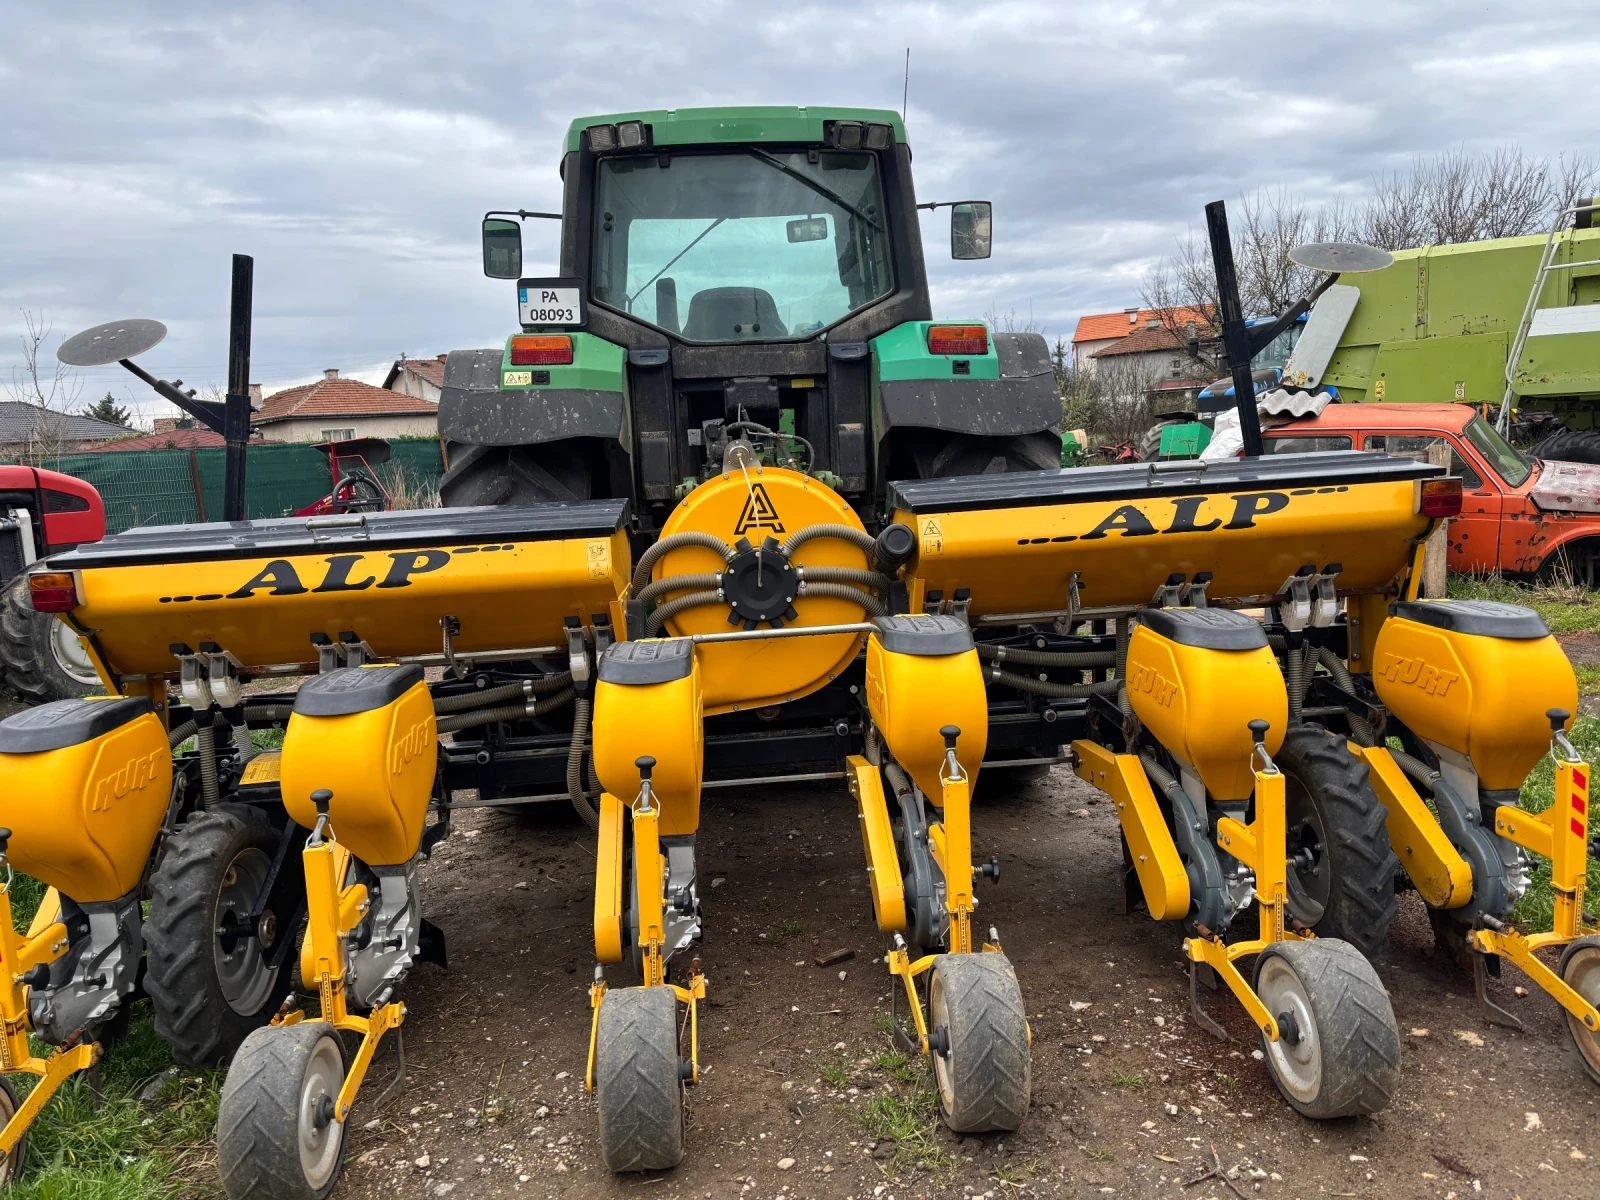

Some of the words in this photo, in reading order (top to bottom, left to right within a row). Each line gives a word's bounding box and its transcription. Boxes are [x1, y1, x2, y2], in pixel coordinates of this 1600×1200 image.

[530, 308, 573, 321] 08093
[541, 290, 559, 303] PA
[1079, 491, 1290, 540] ALP
[226, 549, 451, 599] ALP
[1128, 660, 1178, 708] KURT
[1377, 652, 1460, 698] KURT
[393, 714, 434, 775] KURT
[92, 747, 165, 813] KURT
